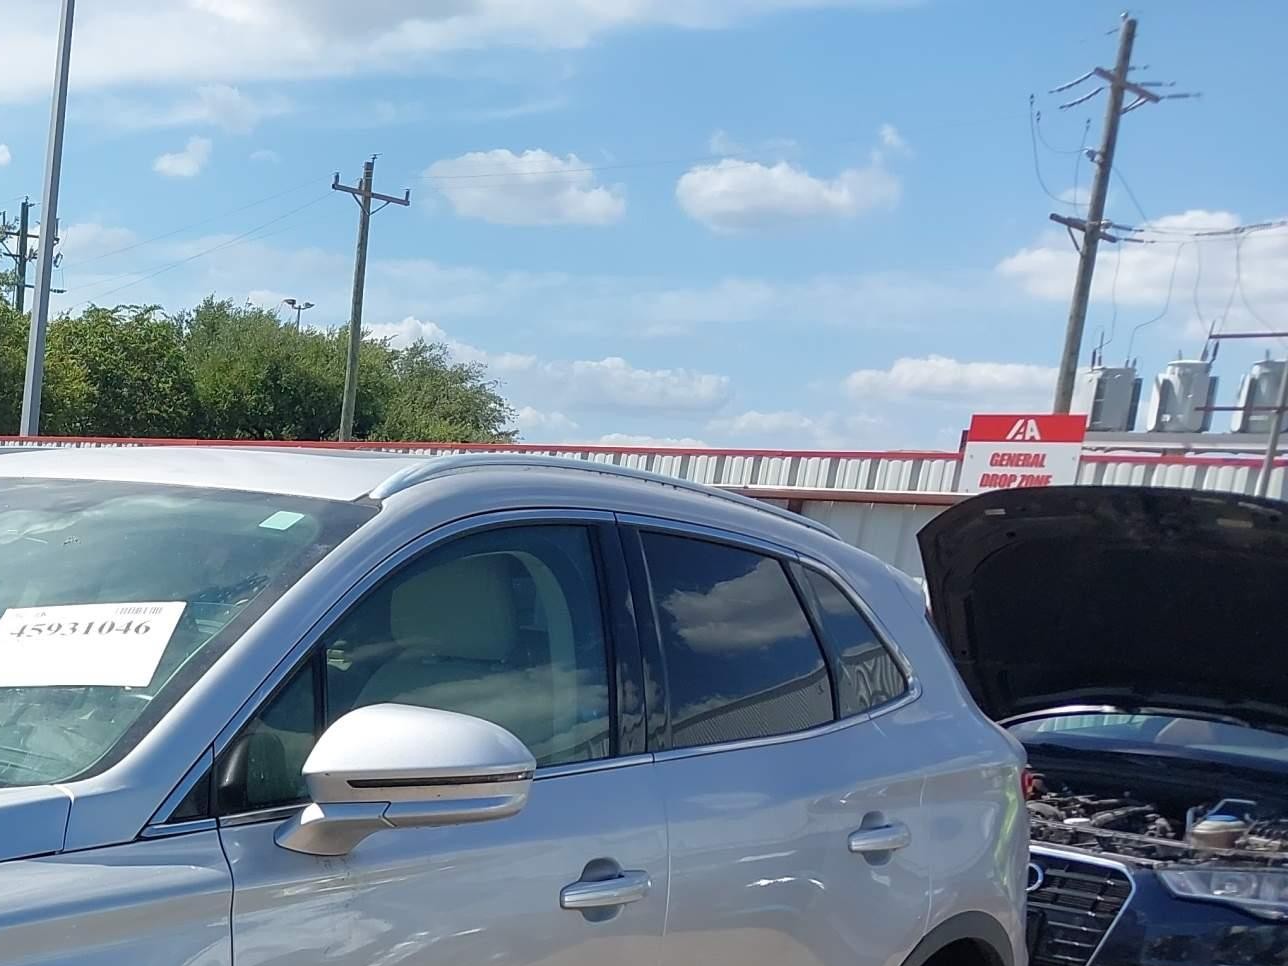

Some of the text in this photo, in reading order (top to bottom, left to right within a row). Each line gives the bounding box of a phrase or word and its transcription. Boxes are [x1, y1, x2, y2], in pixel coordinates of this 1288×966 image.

[989, 452, 1047, 468] GENERAL
[979, 473, 1053, 488] DROP ZONE
[9, 619, 152, 639] 45931046
